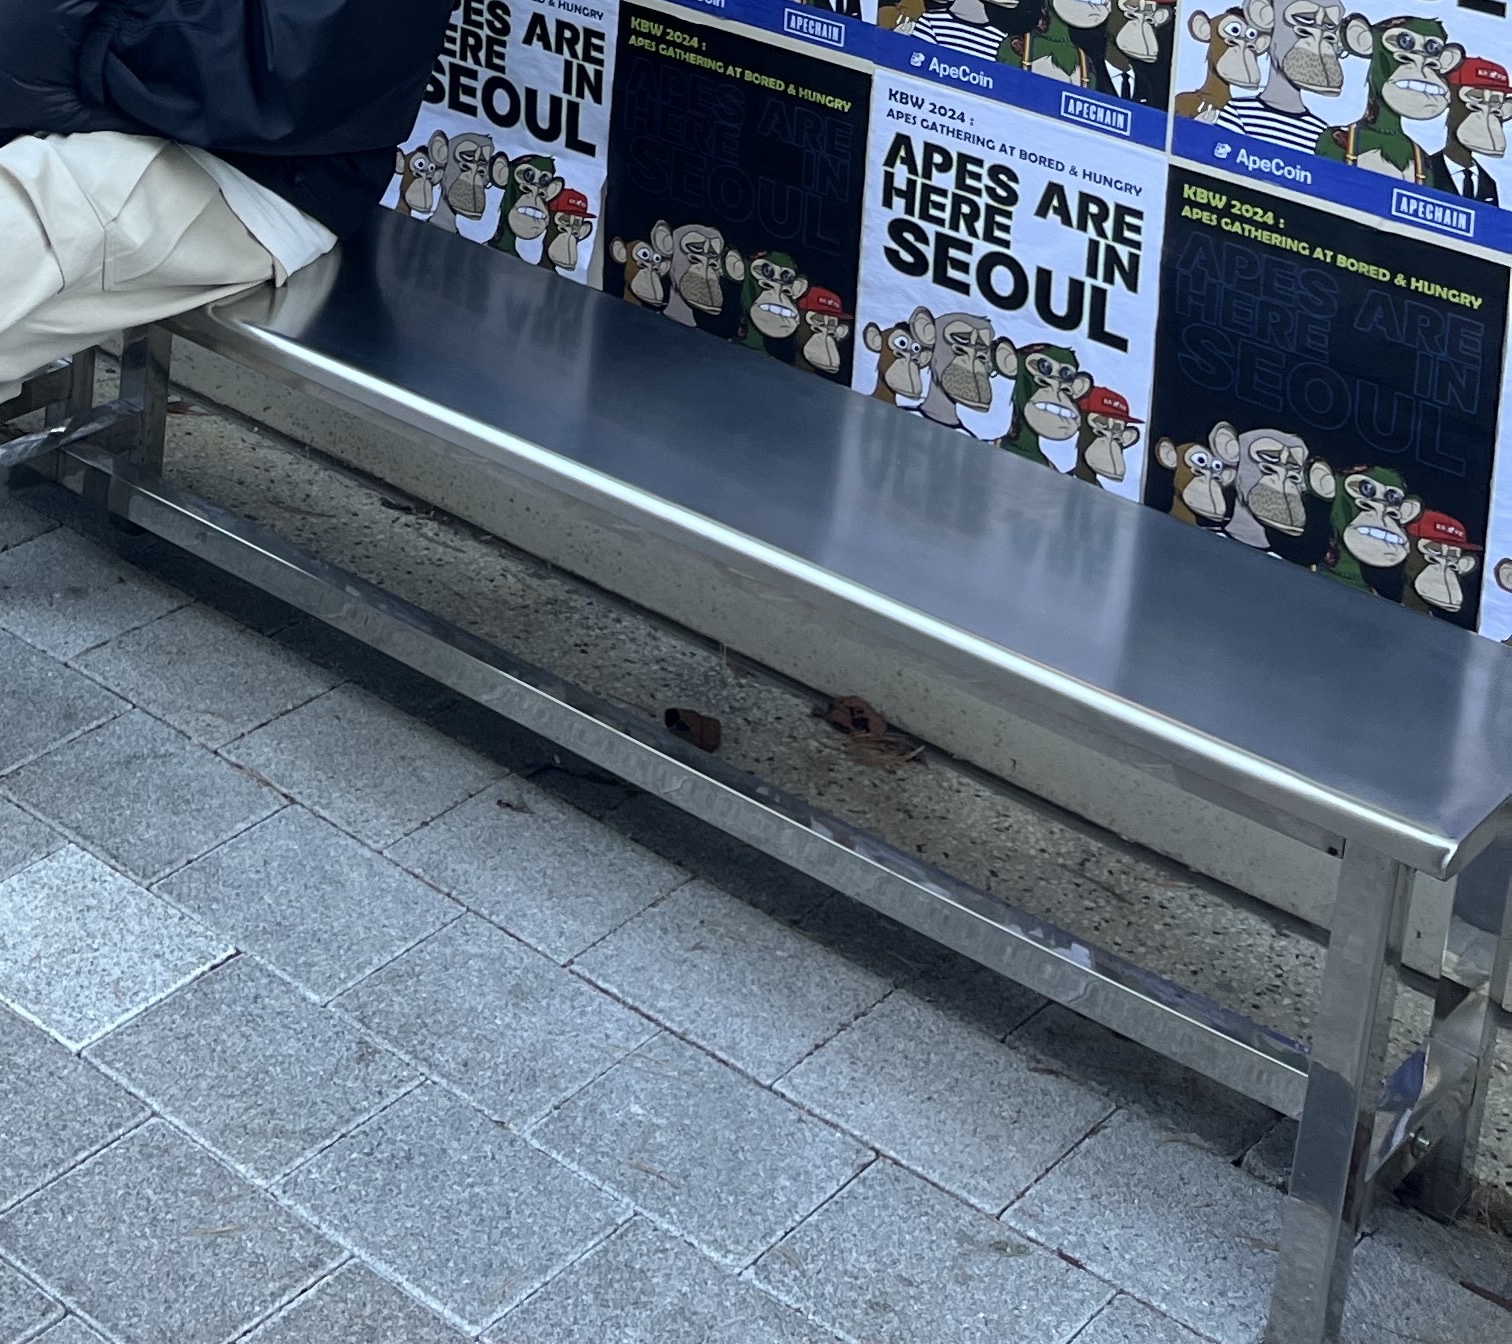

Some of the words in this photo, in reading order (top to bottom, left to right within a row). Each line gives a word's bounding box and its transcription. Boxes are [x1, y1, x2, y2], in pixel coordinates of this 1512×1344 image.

[522, 12, 605, 60] ARE
[632, 18, 663, 36] KBW
[789, 15, 839, 45] APECHAIN
[563, 60, 603, 105] IN
[630, 36, 656, 51] APES
[659, 44, 723, 72] GATHERING
[726, 65, 741, 76] AT
[744, 70, 783, 89] BORED
[787, 83, 795, 94] &
[798, 86, 850, 109] HUNGRY
[928, 57, 993, 88] ApeCoin
[421, 59, 596, 158] SEOUL
[889, 88, 925, 109] KBW
[1066, 99, 1124, 133] APECHAIN
[887, 108, 916, 125] APES
[920, 118, 994, 150] GATHERING
[997, 143, 1015, 156] AT
[1019, 149, 1064, 171] BORED
[1068, 165, 1078, 177] &
[1082, 169, 1143, 196] HUNGRY
[1235, 148, 1311, 184] ApeCoin
[883, 132, 1018, 207] APES
[1034, 181, 1144, 251] ARE
[1185, 185, 1228, 208] KBW
[882, 169, 1012, 249] HERE
[1085, 237, 1139, 293] IN
[1398, 196, 1466, 234] APECHAIN
[1183, 206, 1218, 225] APES
[1223, 218, 1309, 255] GATHERING
[1313, 249, 1333, 262] AT
[1337, 255, 1390, 281] BORED
[1395, 275, 1406, 287] &
[1410, 279, 1480, 310] HUNGRY
[884, 217, 1128, 353] SEOUL
